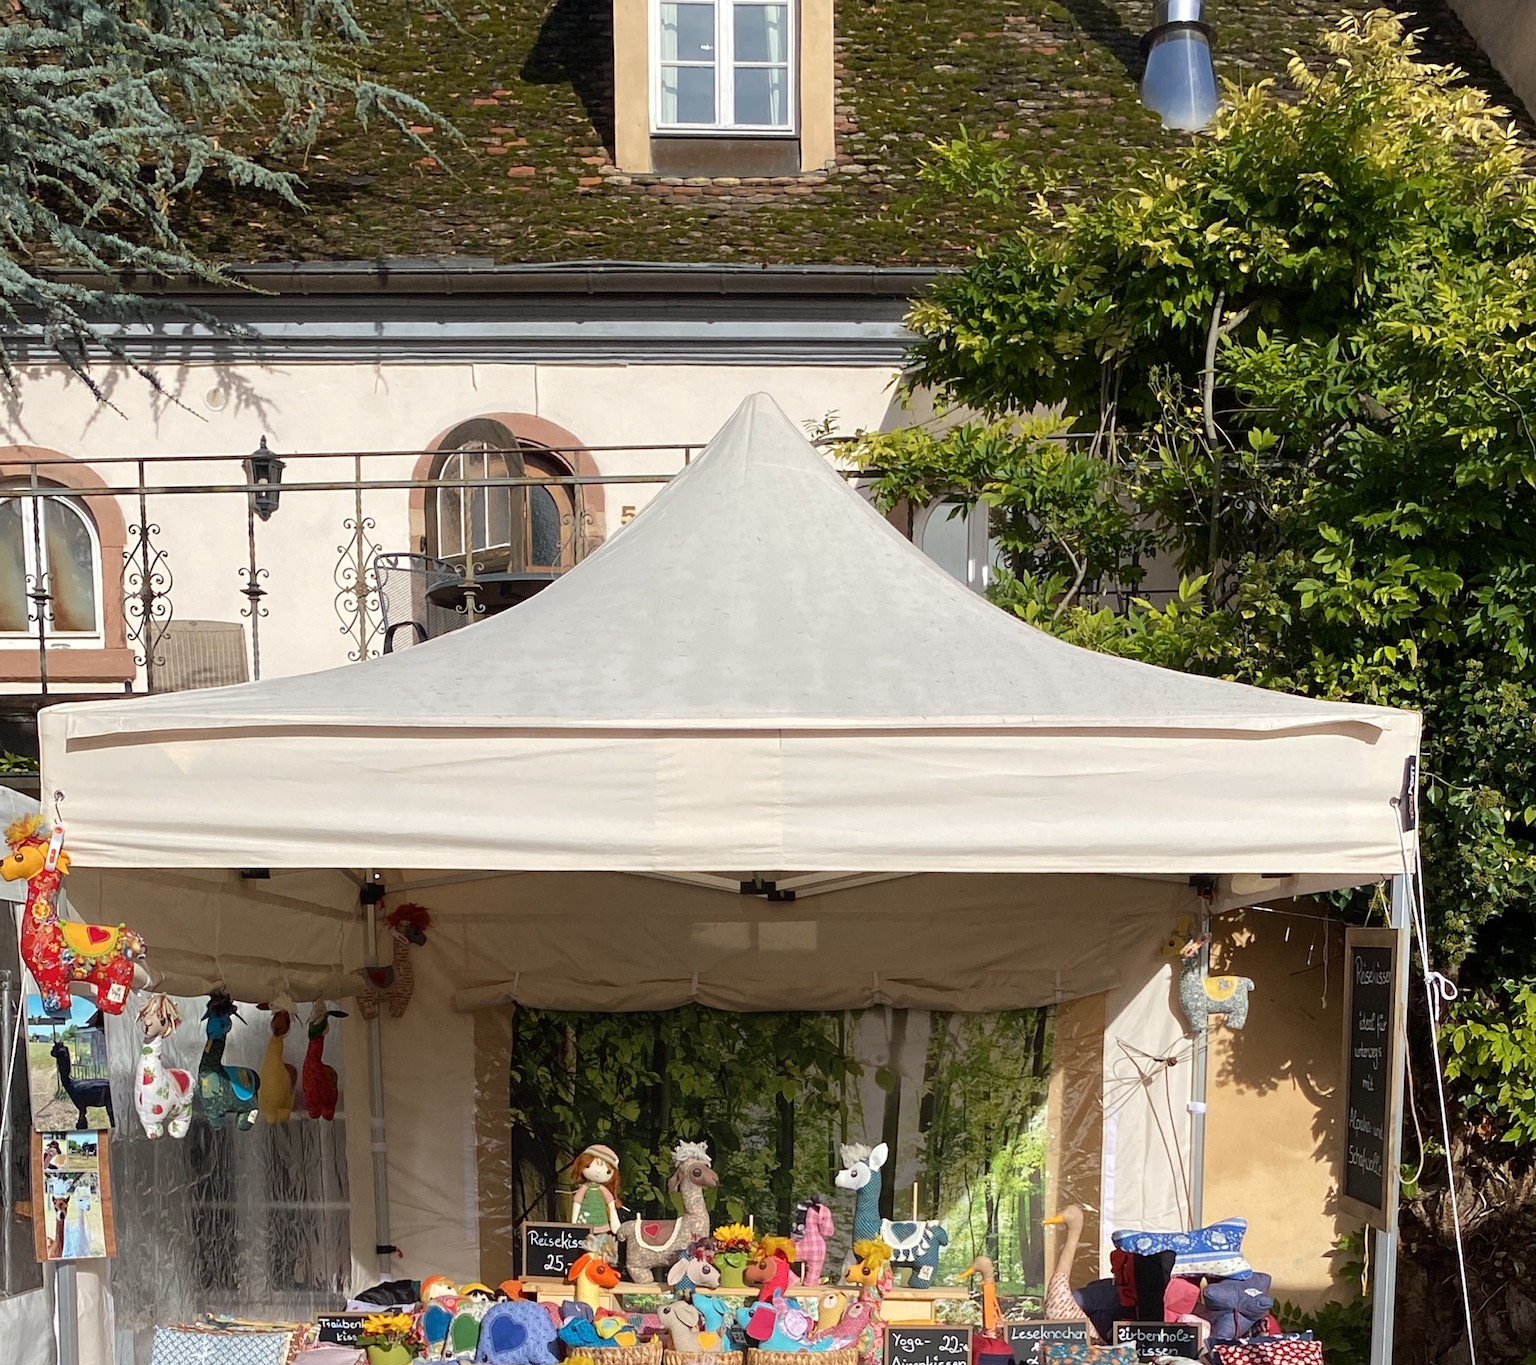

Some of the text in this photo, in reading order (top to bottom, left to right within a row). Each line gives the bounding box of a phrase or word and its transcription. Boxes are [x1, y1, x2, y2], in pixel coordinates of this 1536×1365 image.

[621, 505, 636, 525] 5
[527, 1230, 585, 1250] Reisekiss
[891, 1332, 931, 1353] Yoga-
[1011, 1324, 1088, 1341] Leseknochen
